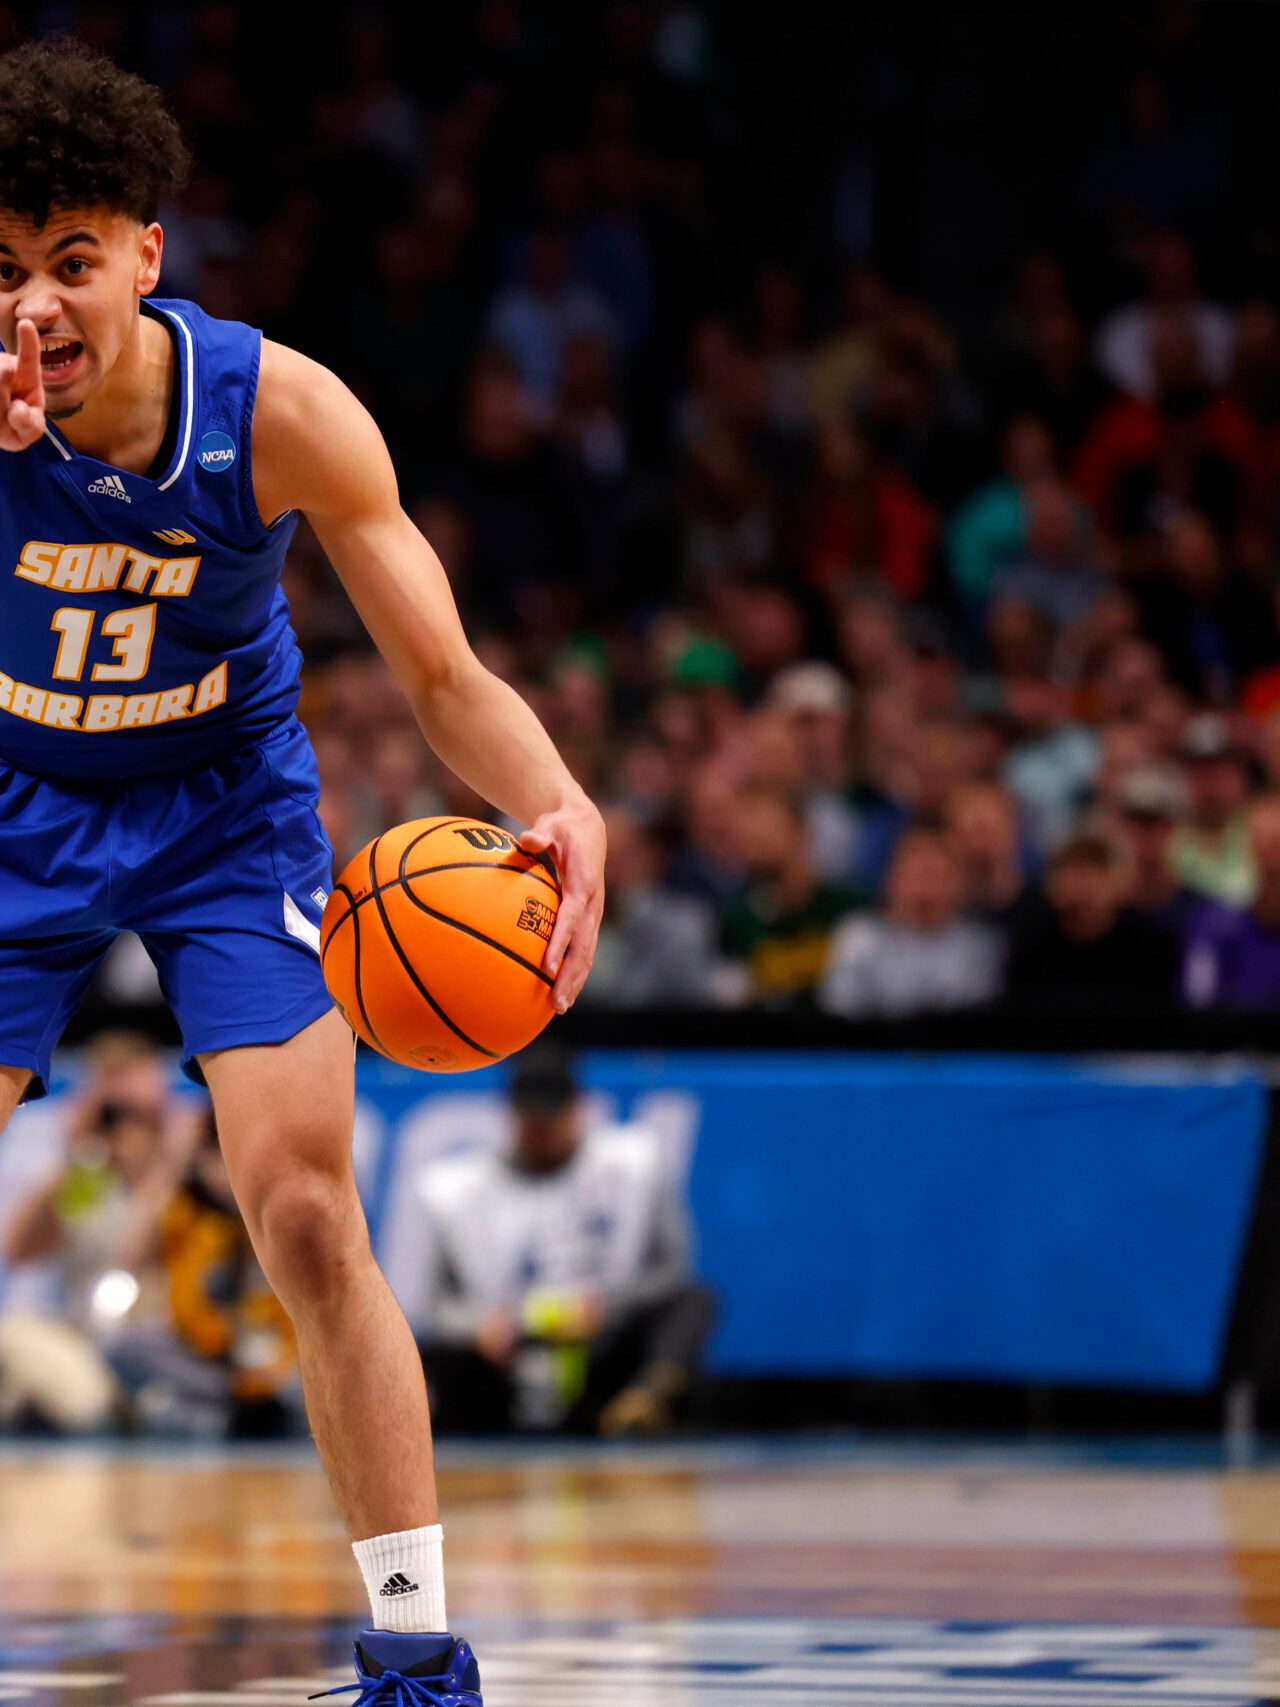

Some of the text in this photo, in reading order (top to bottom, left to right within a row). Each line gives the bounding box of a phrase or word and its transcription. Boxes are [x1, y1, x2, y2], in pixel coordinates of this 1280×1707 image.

[201, 449, 234, 463] NCAA
[87, 484, 132, 504] adidas
[14, 540, 201, 597] SANTA
[50, 602, 157, 682] 13
[379, 1583, 419, 1597] adidas
